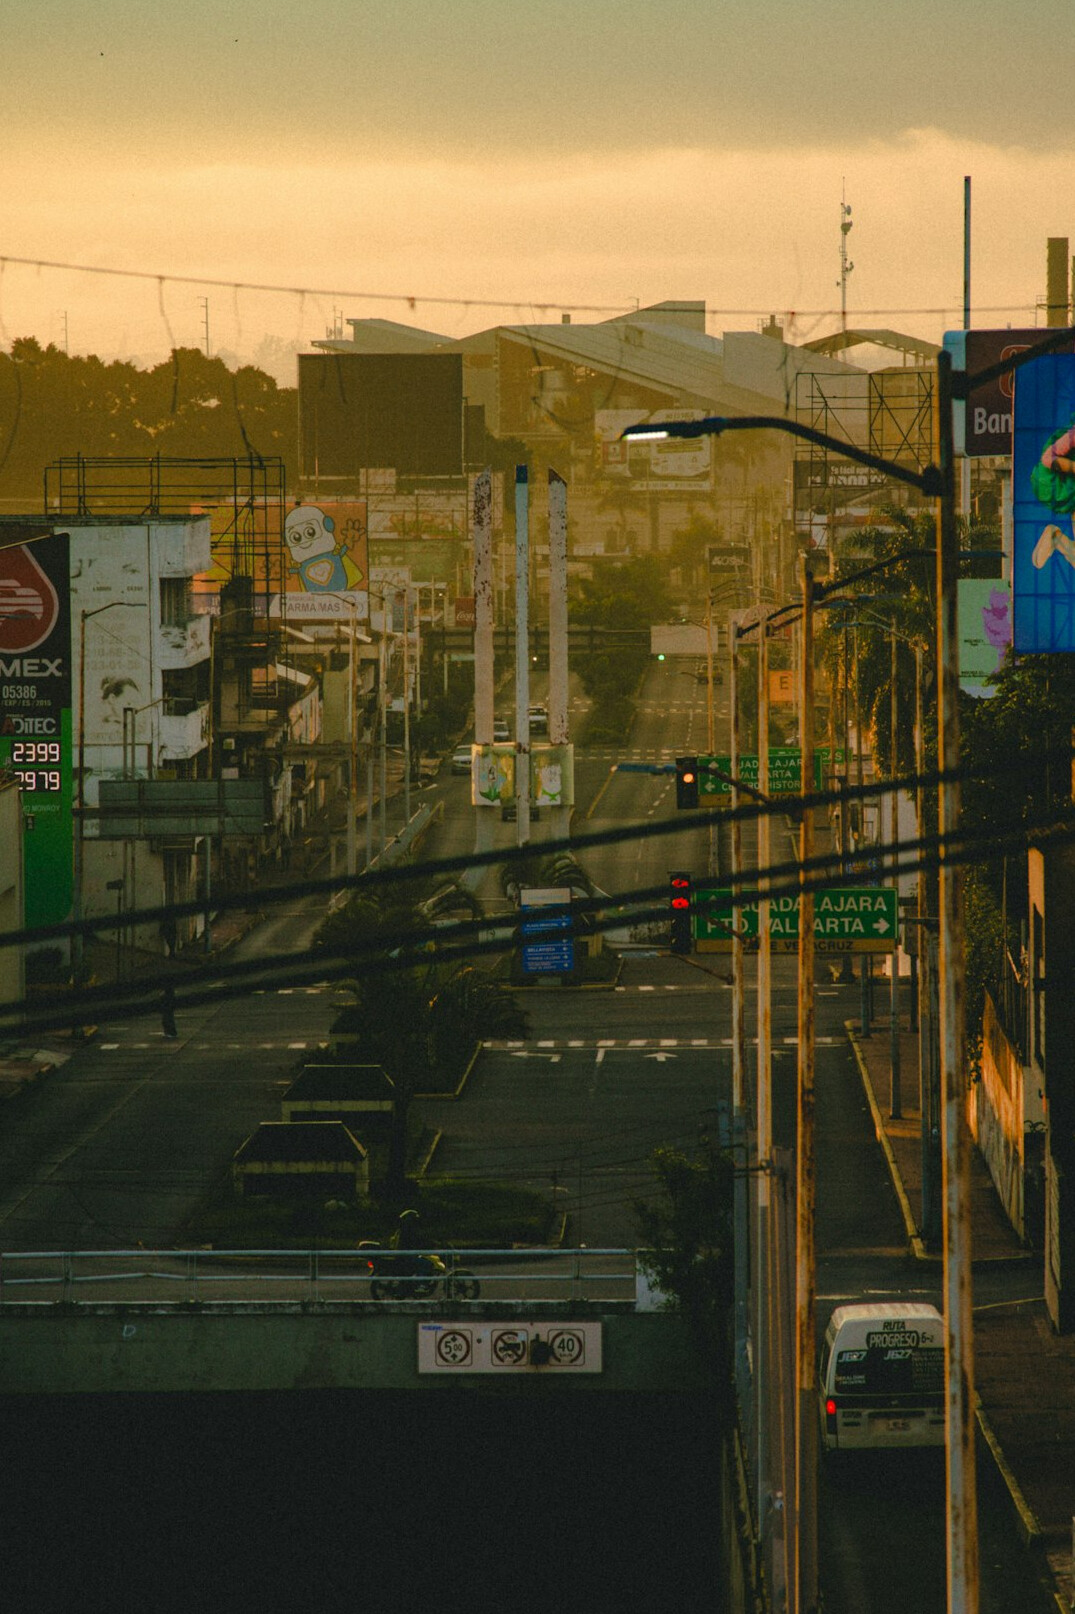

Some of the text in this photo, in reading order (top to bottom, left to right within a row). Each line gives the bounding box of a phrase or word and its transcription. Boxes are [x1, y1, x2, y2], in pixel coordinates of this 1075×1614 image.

[2, 685, 37, 699] 05386
[13, 743, 60, 762] 2399
[883, 1321, 906, 1331] RUTA
[557, 1338, 575, 1353] 40
[869, 1332, 917, 1347] PROGRESO
